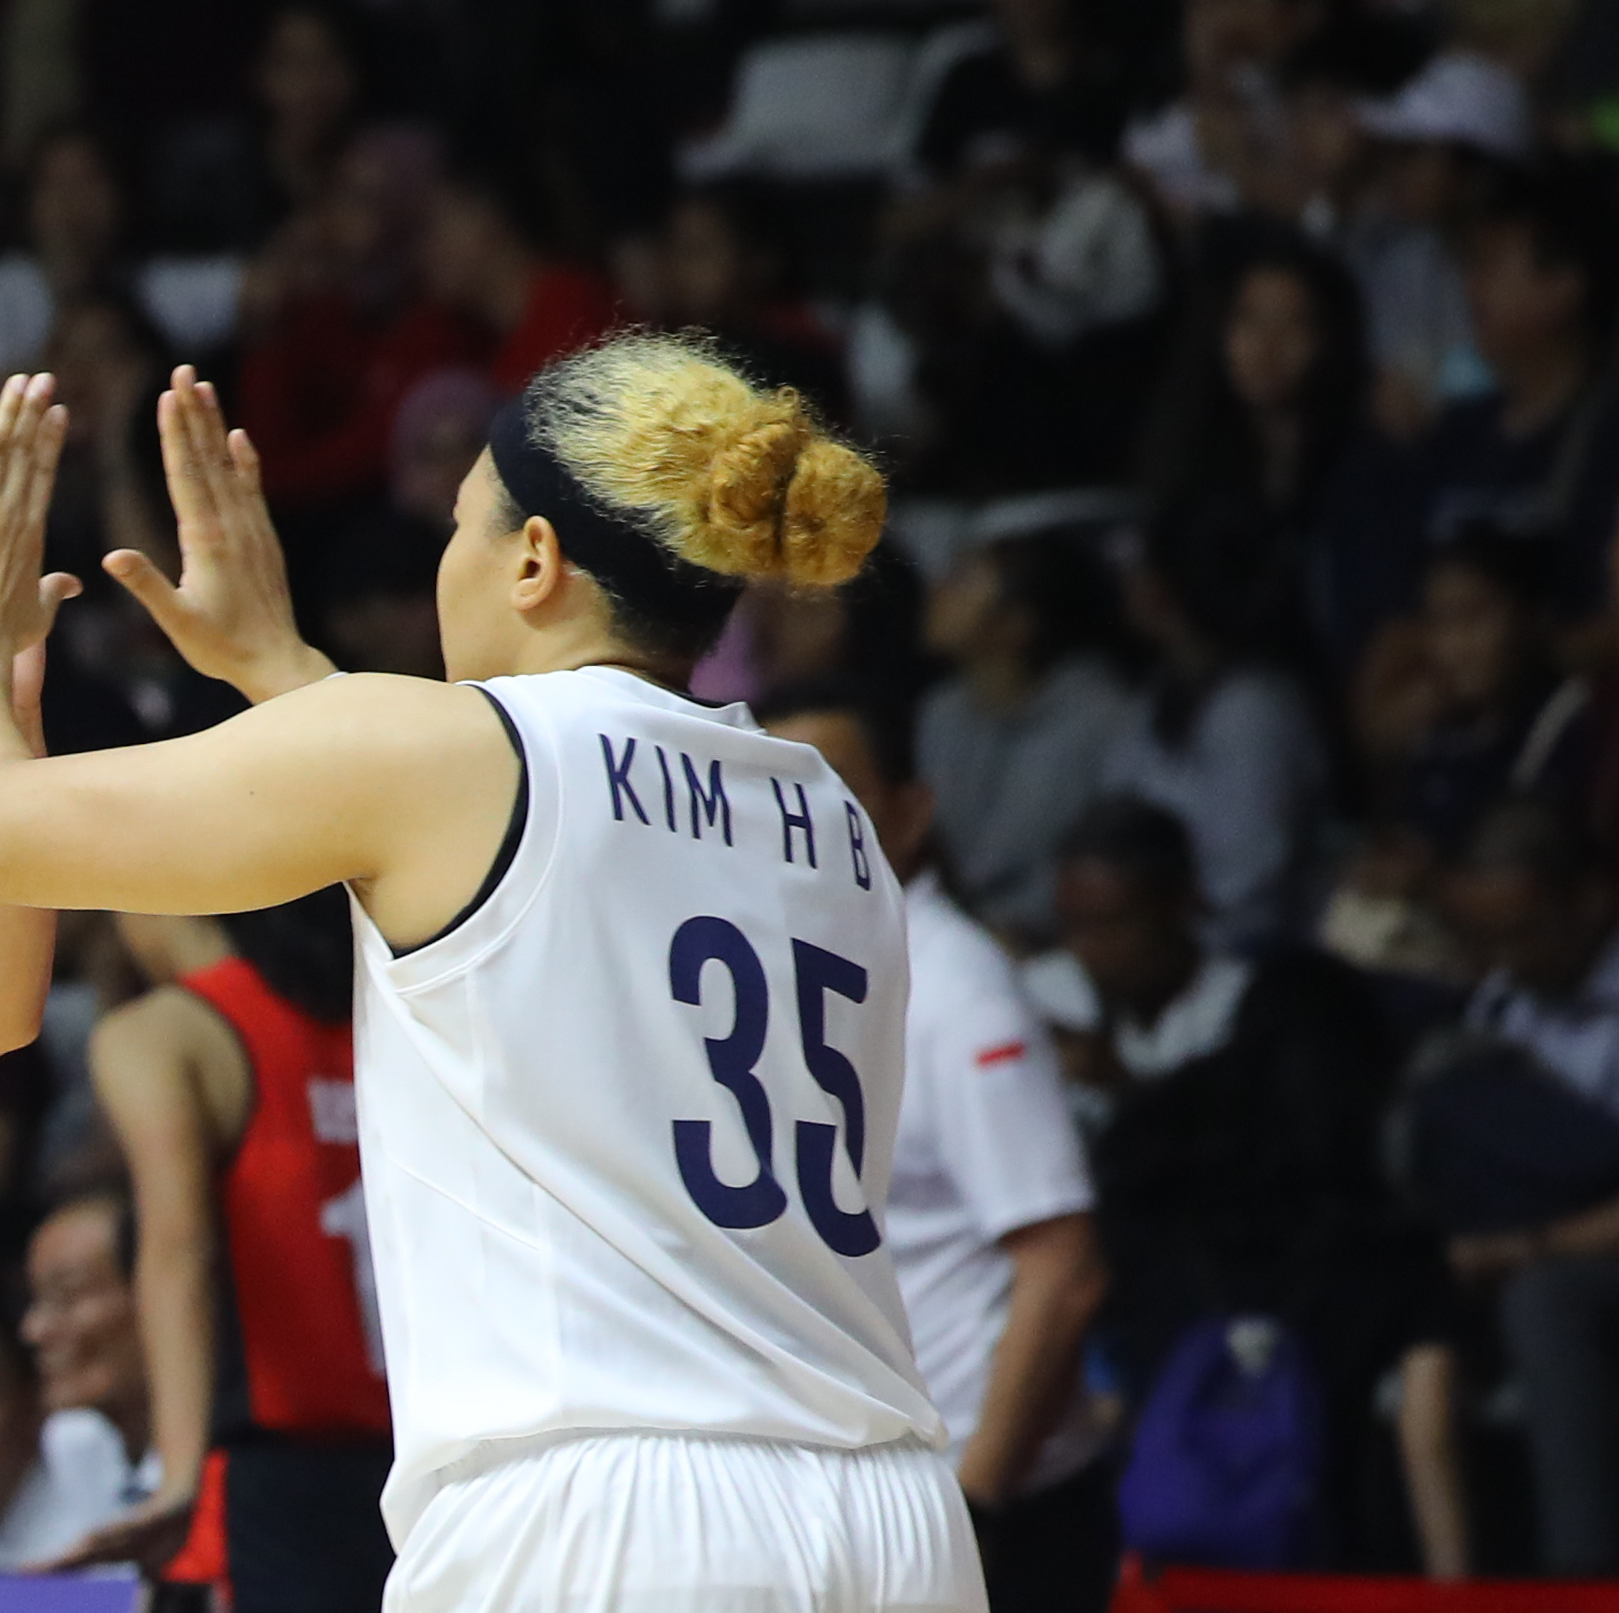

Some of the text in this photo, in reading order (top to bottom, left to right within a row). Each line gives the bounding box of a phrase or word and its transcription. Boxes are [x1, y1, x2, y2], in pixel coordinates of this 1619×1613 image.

[597, 732, 734, 848] KIM
[769, 776, 818, 870] H
[668, 914, 883, 1259] 35
